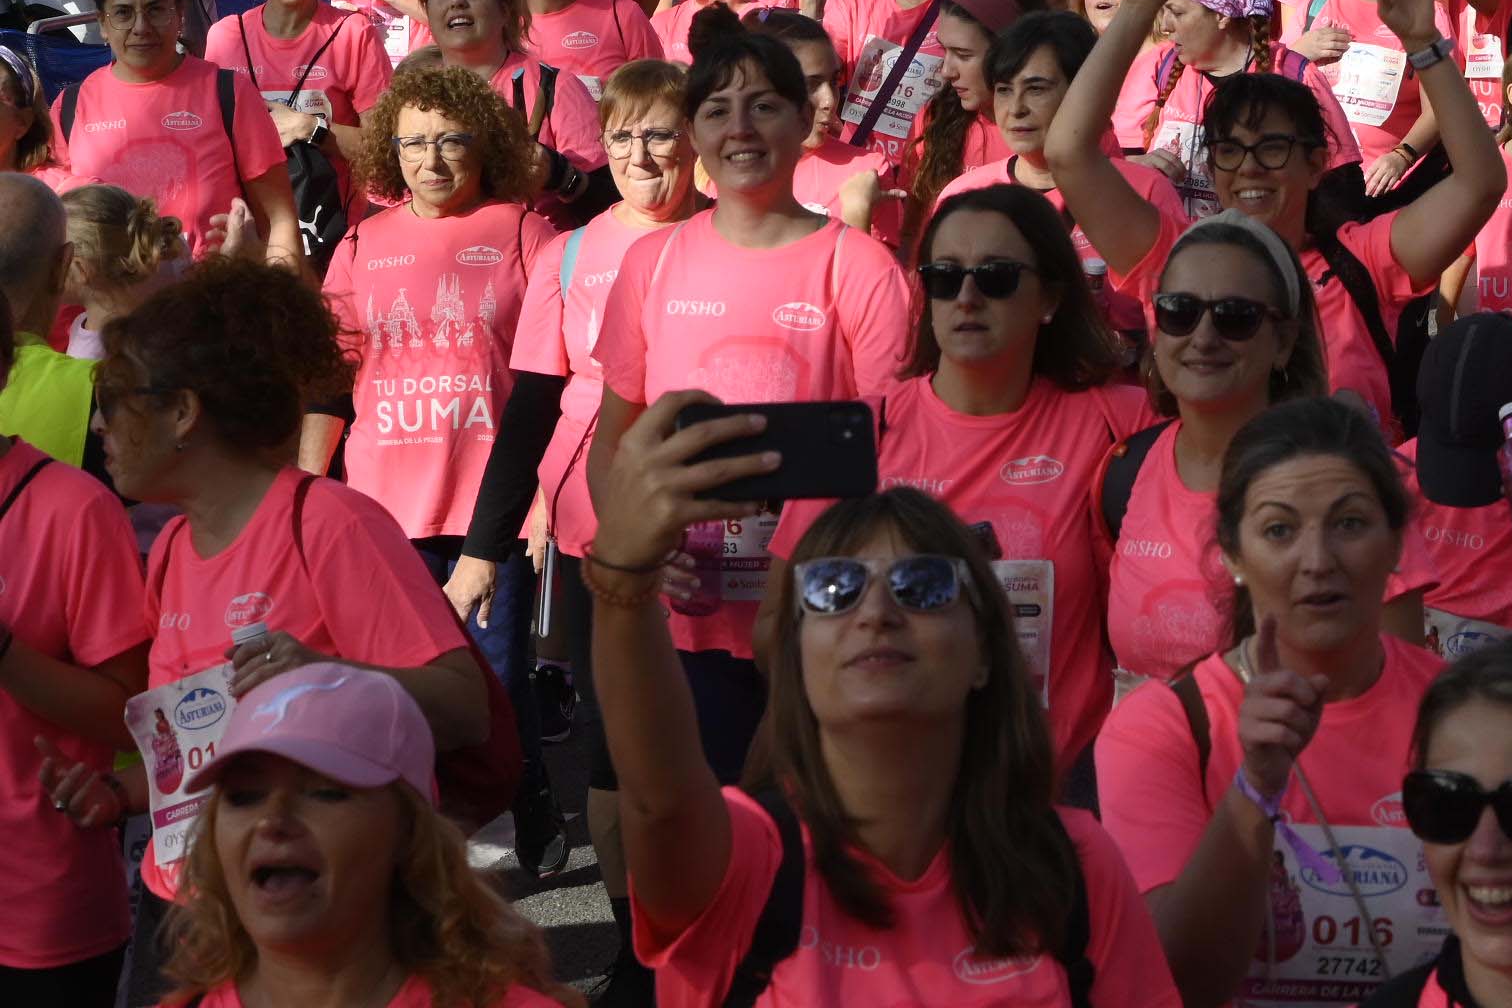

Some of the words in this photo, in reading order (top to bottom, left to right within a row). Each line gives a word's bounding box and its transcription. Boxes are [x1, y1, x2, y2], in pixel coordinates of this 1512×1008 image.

[84, 119, 127, 132] OYSHO
[367, 254, 415, 270] OYSHO
[1479, 277, 1509, 298] TU
[667, 300, 726, 317] OYSHO
[373, 379, 396, 397] TU
[403, 374, 493, 394] DORSAL
[377, 396, 496, 434] SUMA
[1004, 582, 1039, 592] SUMA
[180, 701, 224, 725] ASTURIANA
[188, 742, 216, 770] 01
[1312, 915, 1394, 947] 016
[1316, 957, 1383, 977] 27742
